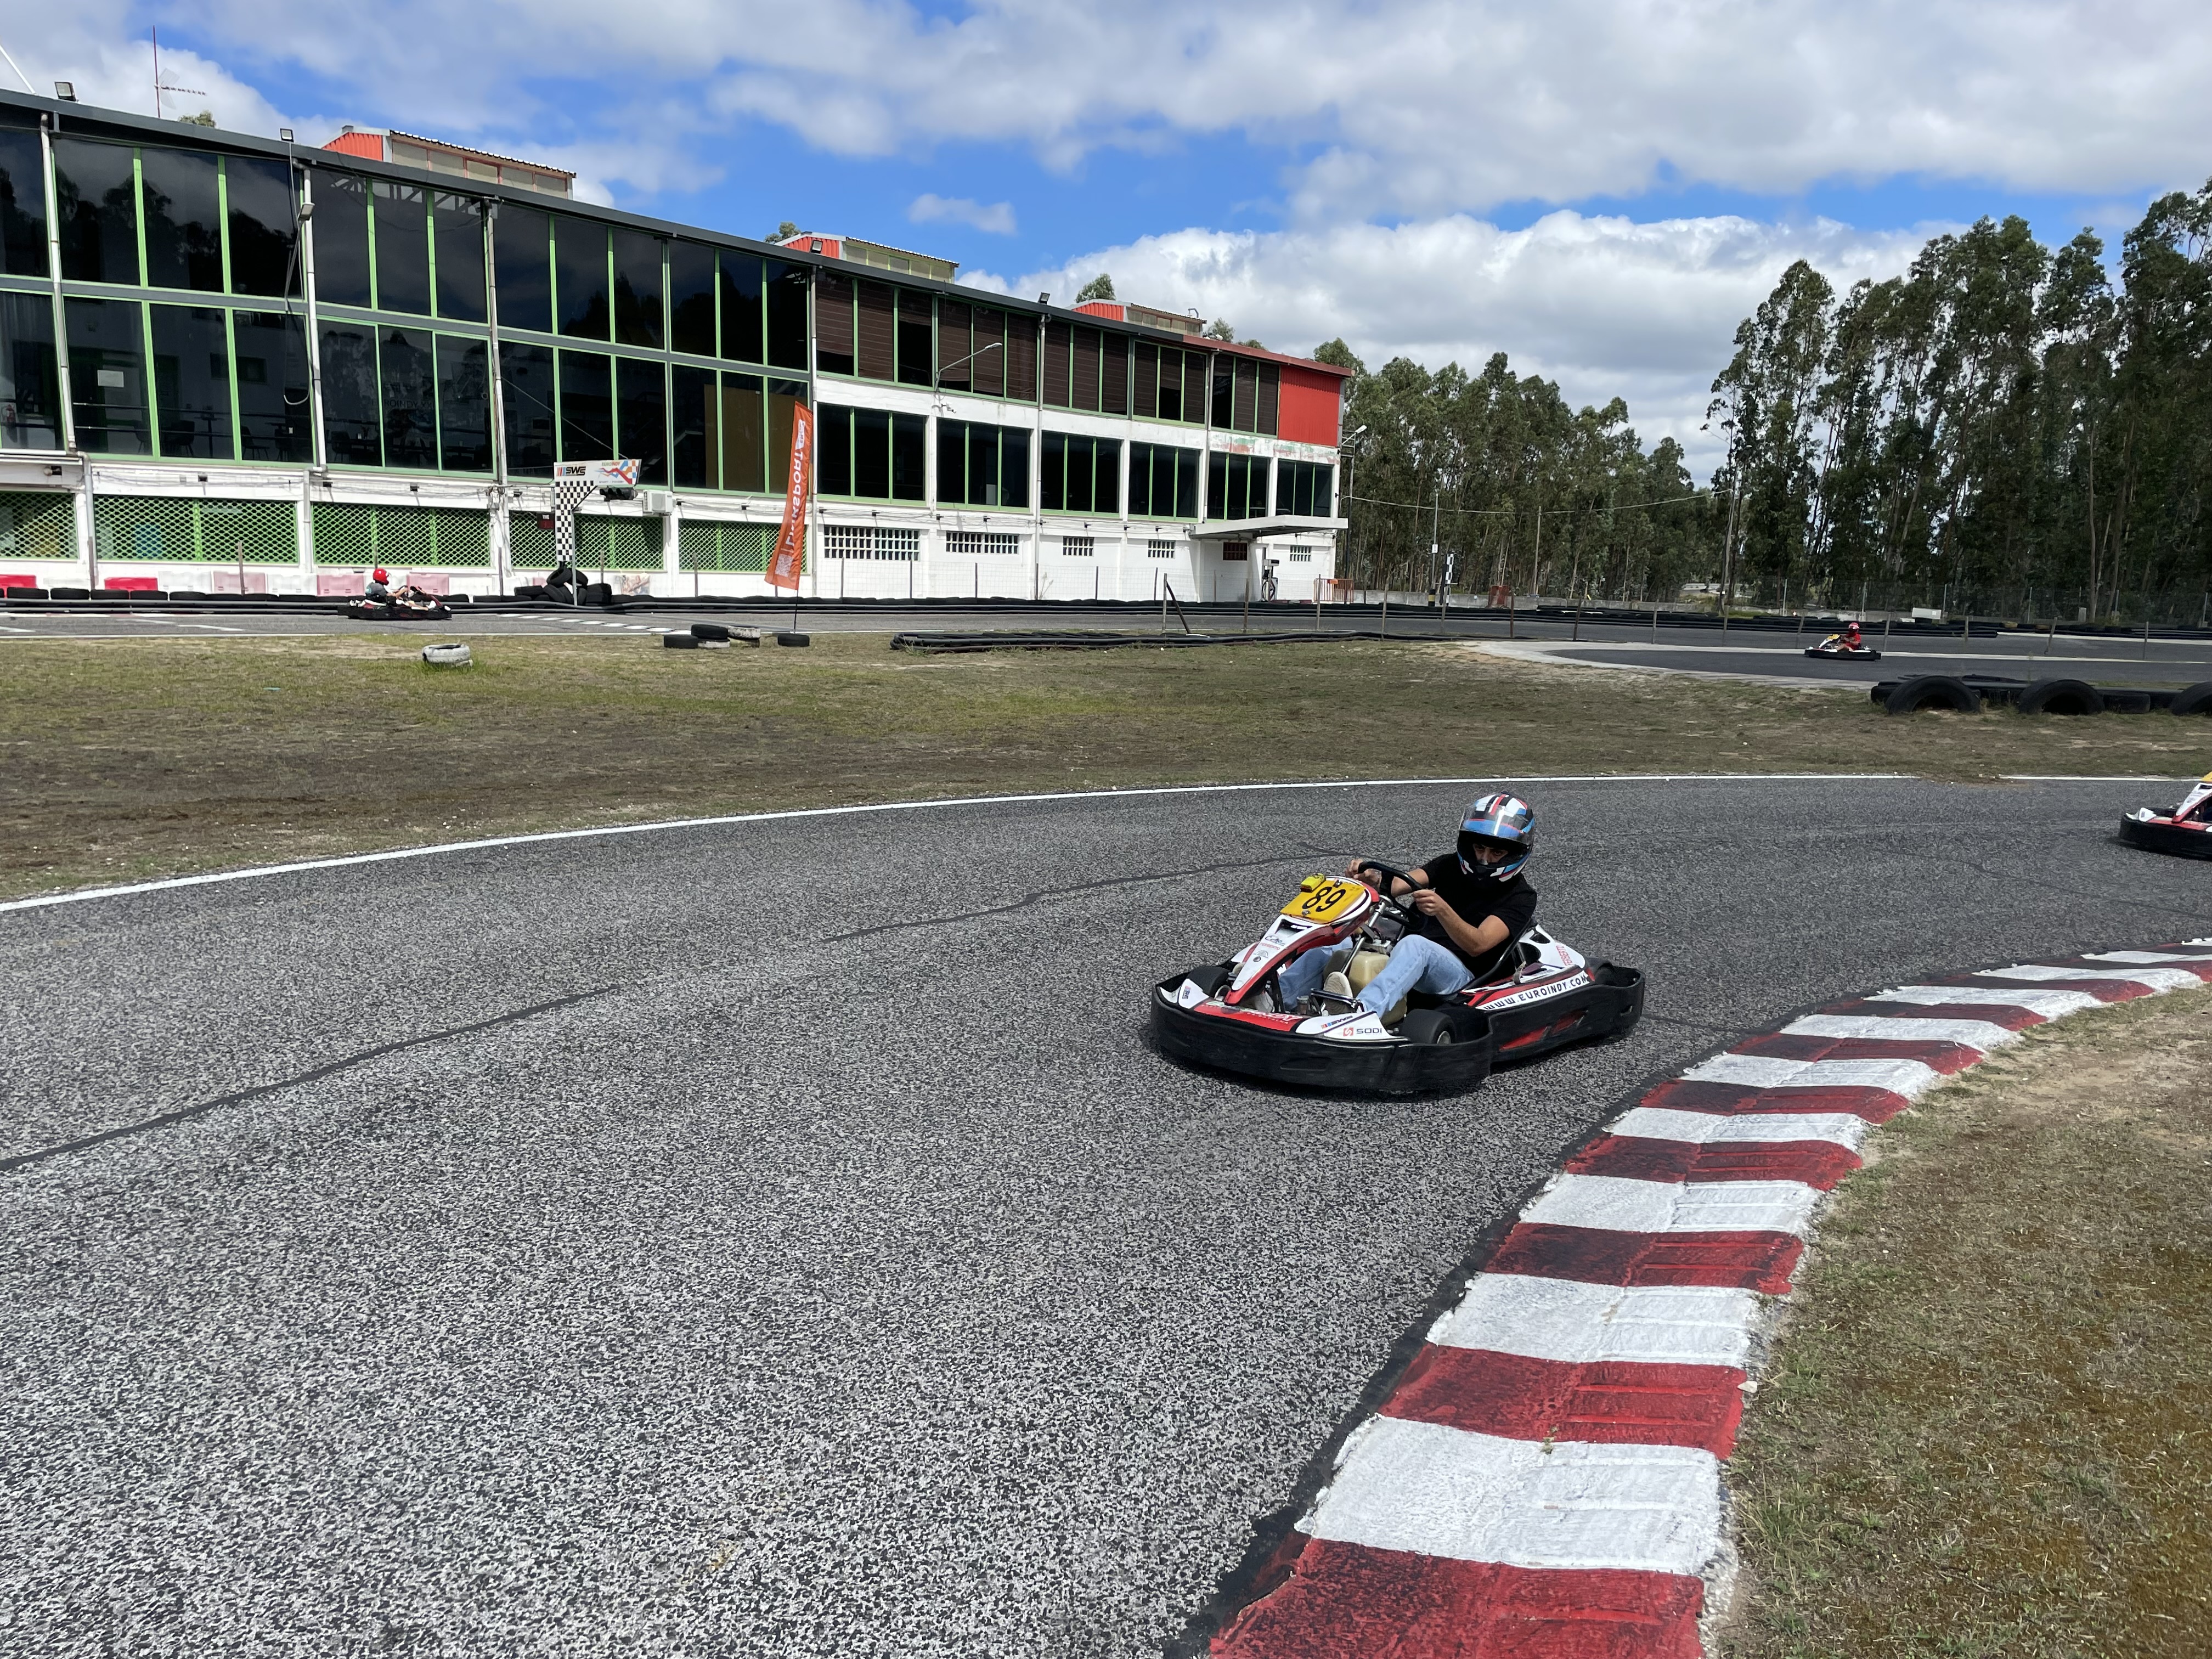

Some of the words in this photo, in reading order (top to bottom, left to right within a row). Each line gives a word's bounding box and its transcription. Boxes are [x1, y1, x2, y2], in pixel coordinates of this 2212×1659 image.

[566, 466, 586, 476] SWS
[1302, 887, 1346, 912] 89
[1483, 975, 1588, 1011] WWW.EUROINDY.COM
